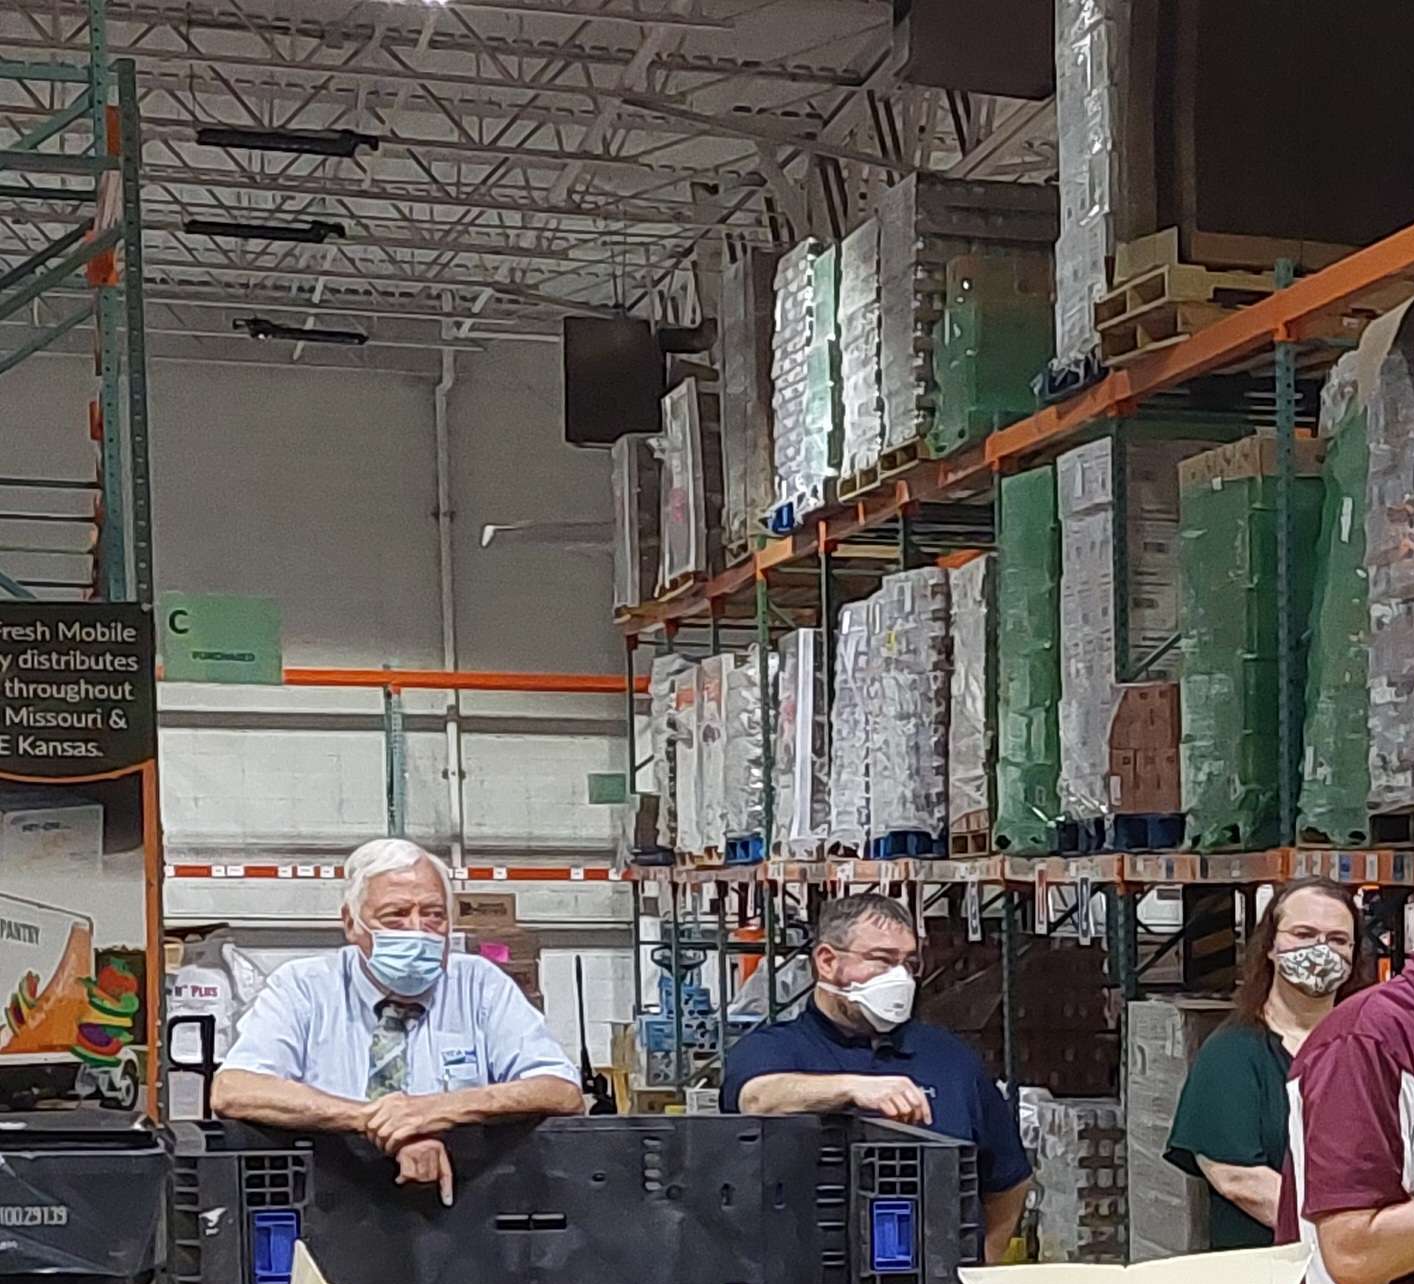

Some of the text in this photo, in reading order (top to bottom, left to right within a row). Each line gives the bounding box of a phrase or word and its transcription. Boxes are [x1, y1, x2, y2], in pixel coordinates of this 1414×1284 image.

[0, 621, 137, 642] resh Mobile
[168, 609, 190, 635] C
[18, 649, 139, 671] distributes
[4, 677, 136, 703] throughout
[4, 706, 128, 729] Missouri &
[18, 735, 105, 757] Kansas.
[0, 918, 41, 945] PANTRY
